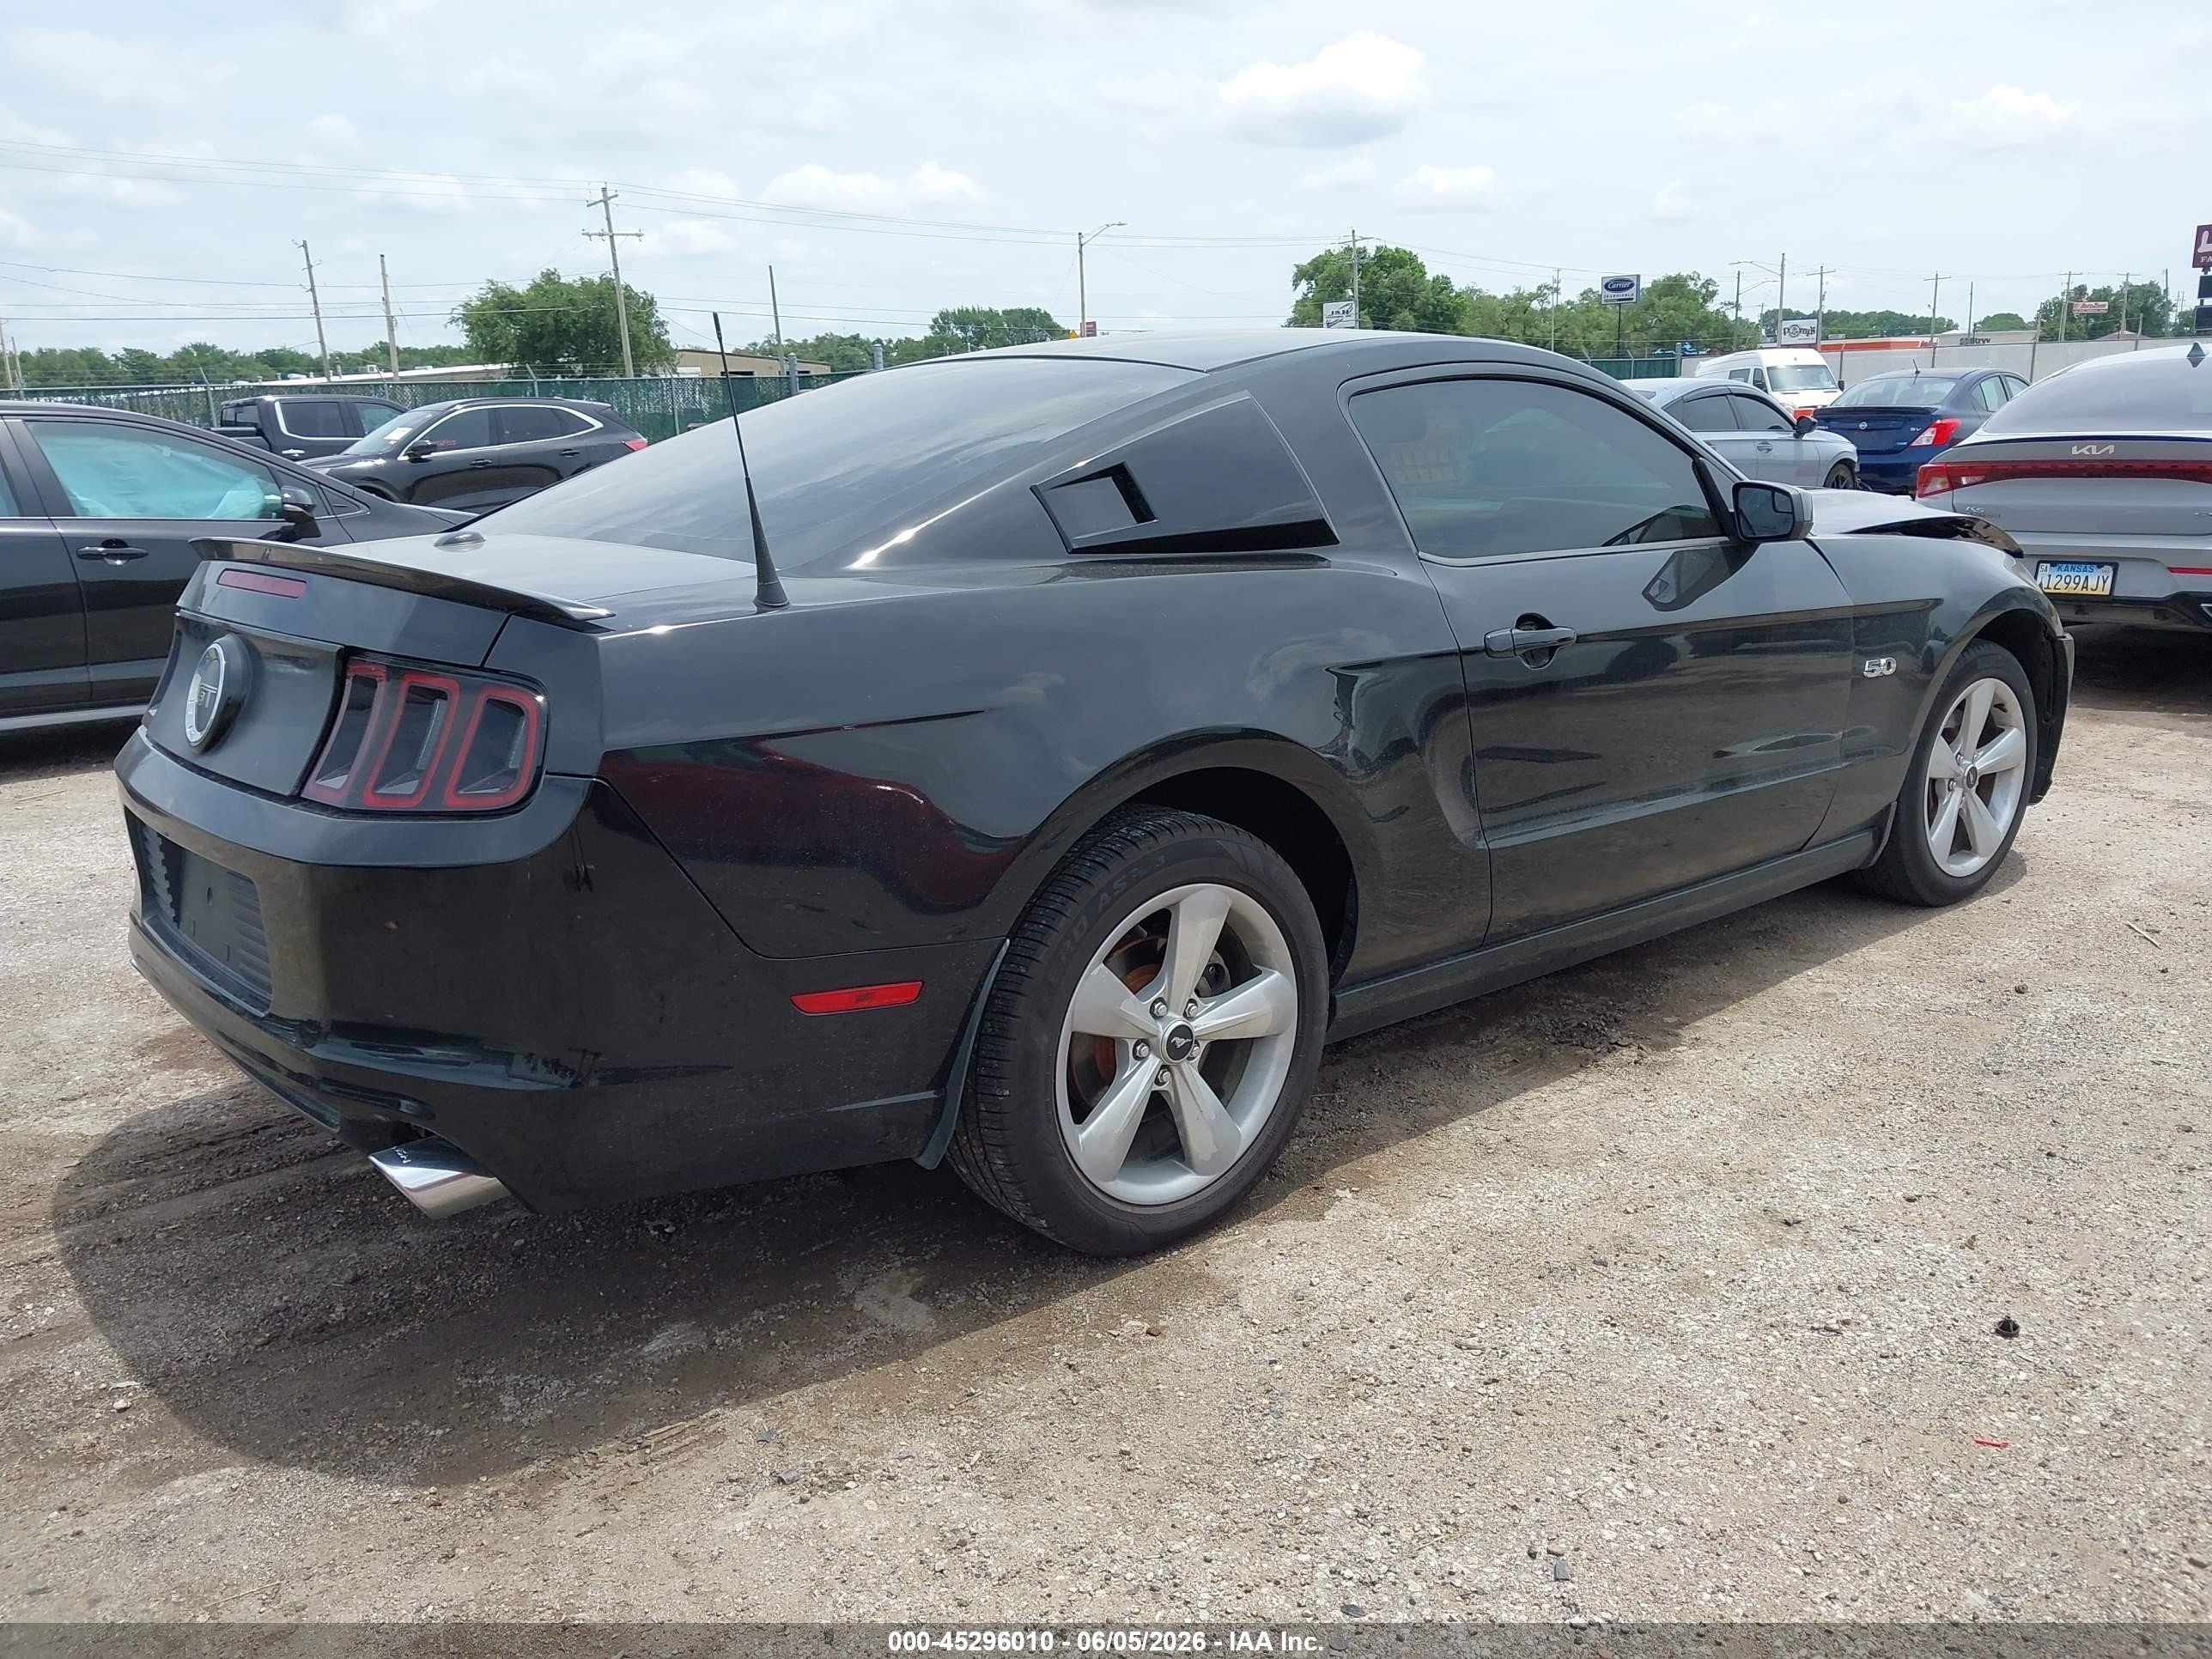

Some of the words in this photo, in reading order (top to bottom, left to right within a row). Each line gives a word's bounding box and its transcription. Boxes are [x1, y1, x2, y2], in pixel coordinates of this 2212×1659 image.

[2071, 445, 2115, 455] KIA
[2057, 564, 2095, 574] KANSAS
[2044, 574, 2110, 592] 1299AJY
[1863, 657, 1897, 678] 5.0
